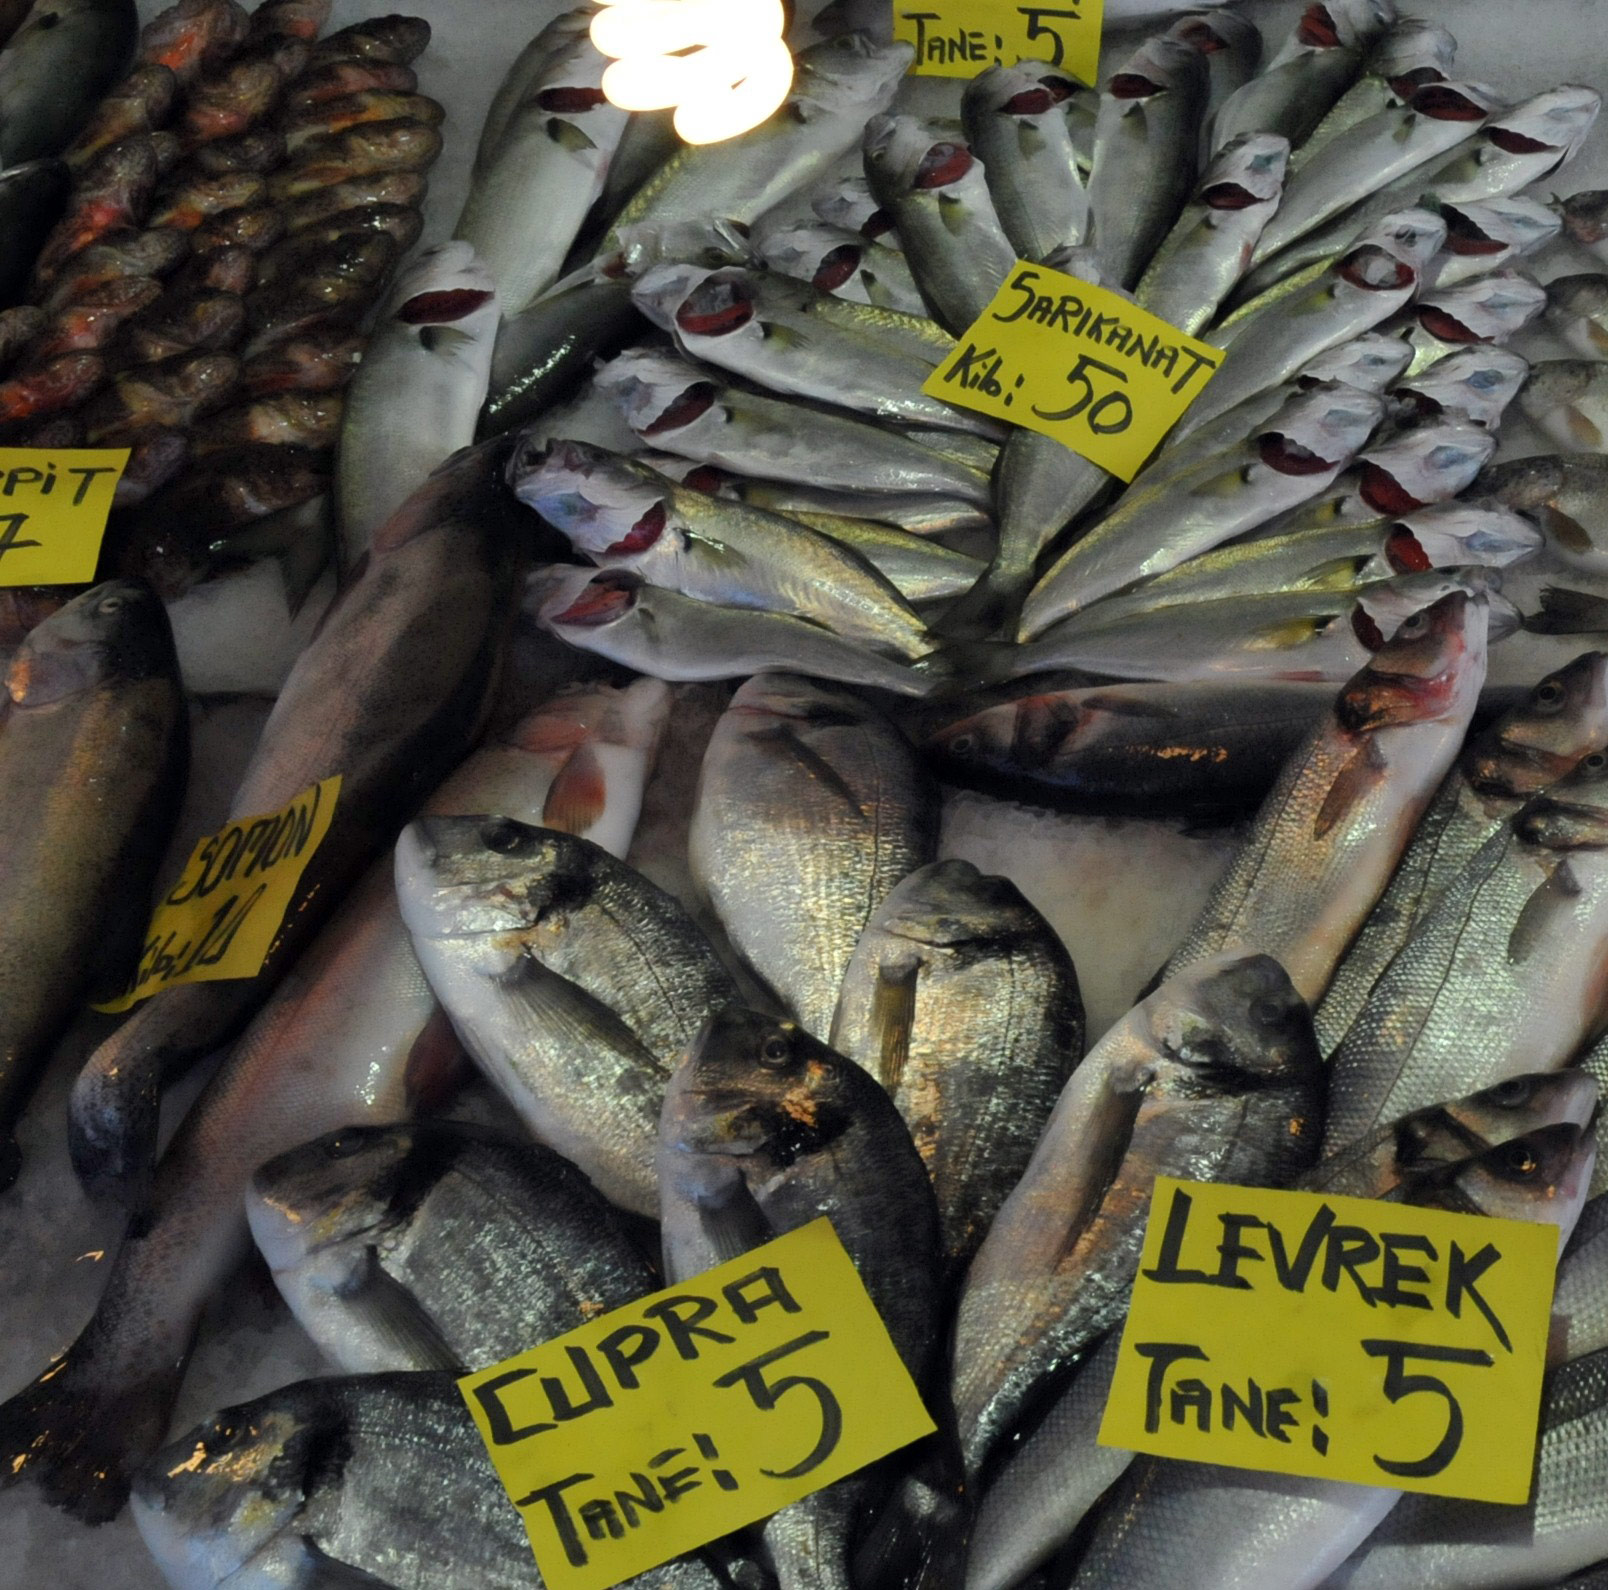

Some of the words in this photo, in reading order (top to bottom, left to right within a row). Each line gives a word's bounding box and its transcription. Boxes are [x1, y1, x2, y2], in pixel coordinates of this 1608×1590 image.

[1016, 7, 1082, 67] 5
[992, 271, 1217, 394] SARIKANAT
[1031, 354, 1133, 435] 50
[1142, 1187, 1514, 1353] LEVREK
[473, 1266, 802, 1446] CUPRA
[713, 1331, 843, 1479] 5
[1360, 1339, 1495, 1478] 5
